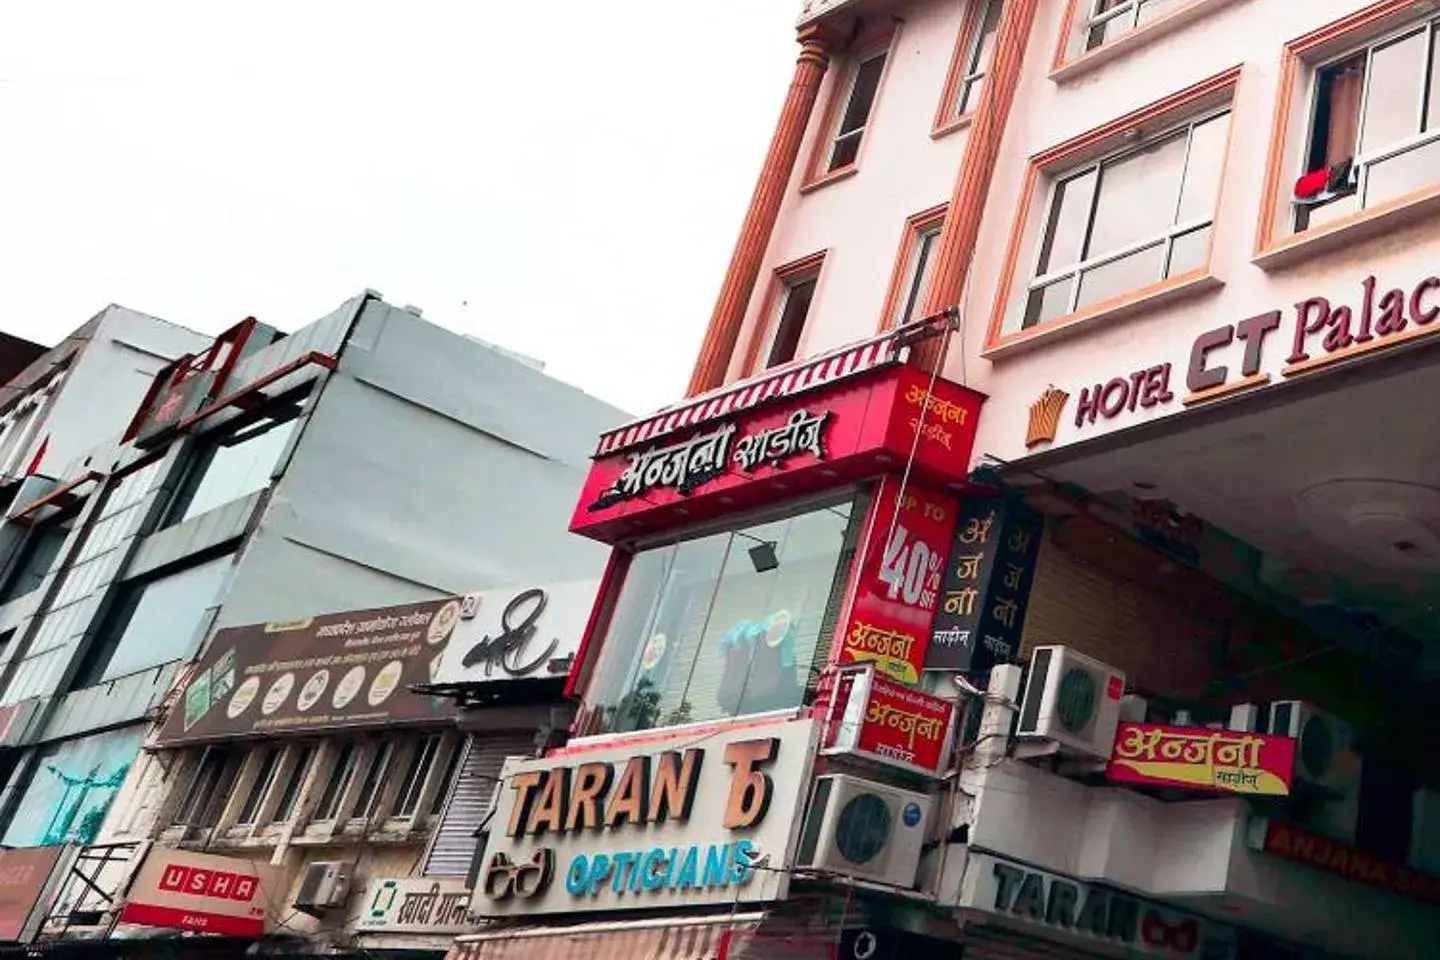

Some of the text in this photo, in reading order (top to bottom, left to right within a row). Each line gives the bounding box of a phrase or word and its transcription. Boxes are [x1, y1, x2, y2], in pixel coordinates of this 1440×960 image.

[1074, 363, 1174, 428] HOTEL
[1186, 310, 1281, 392] CT
[506, 748, 704, 837] TARAN
[166, 868, 253, 901] USHA
[565, 839, 756, 897] OPTICIANS
[994, 863, 1139, 941] TARAN
